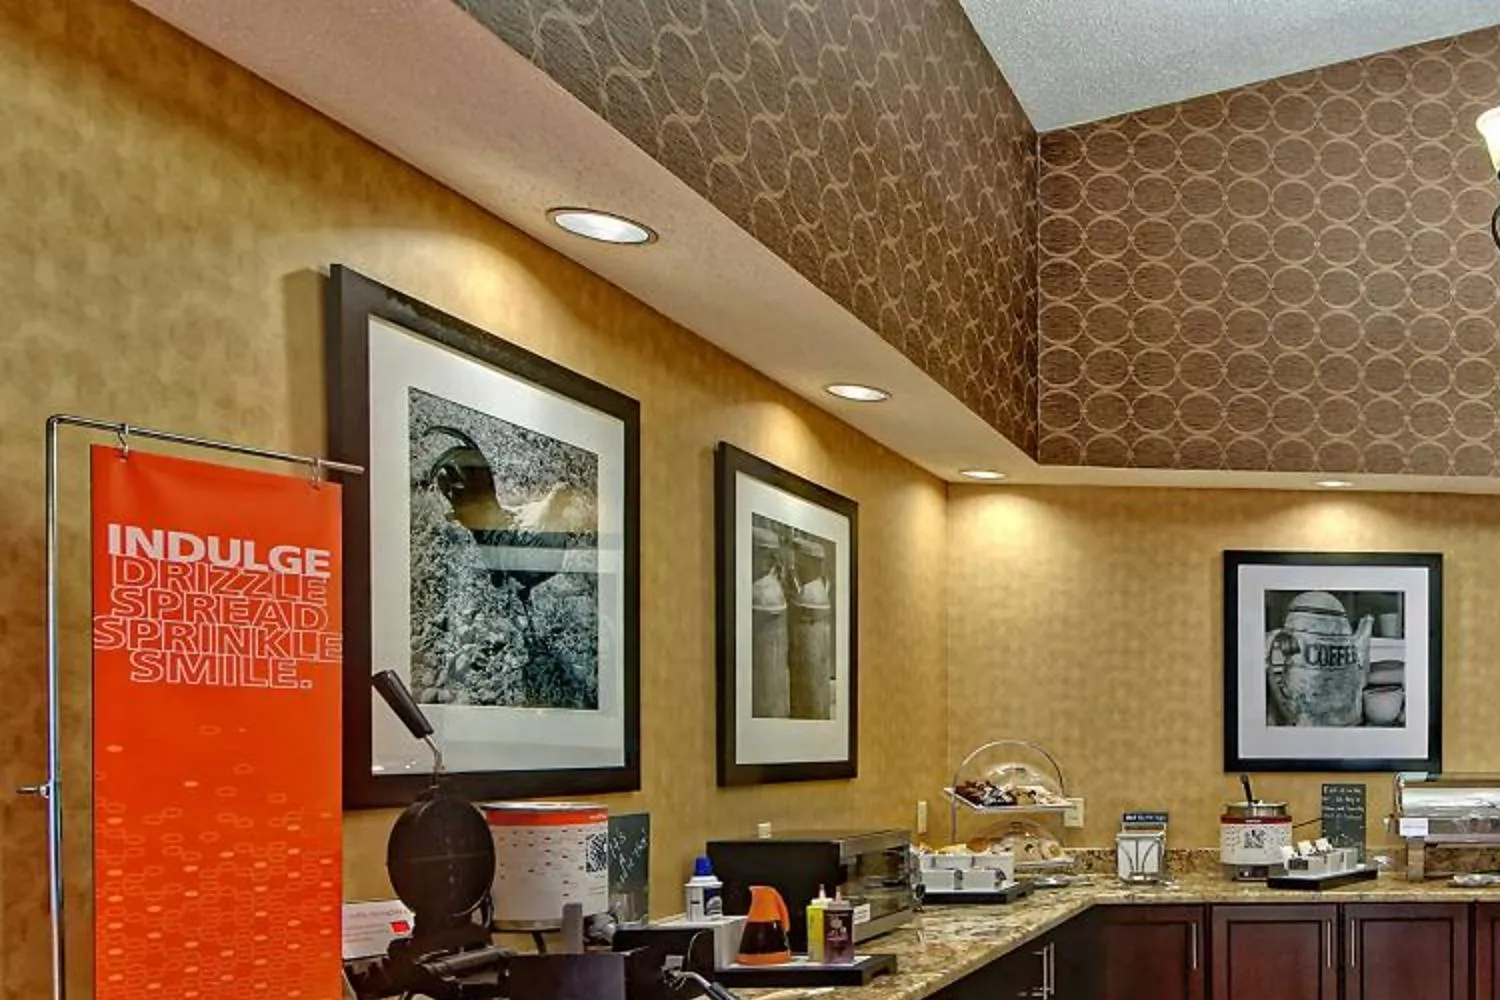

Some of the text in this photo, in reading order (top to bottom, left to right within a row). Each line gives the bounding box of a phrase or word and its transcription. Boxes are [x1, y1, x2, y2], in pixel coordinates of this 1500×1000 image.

[107, 523, 331, 578] INDULGE
[112, 553, 329, 607] DRIZZLE
[110, 586, 330, 633] SPREAD
[93, 614, 344, 664] SPRINKLE
[129, 650, 313, 690] SMILE.
